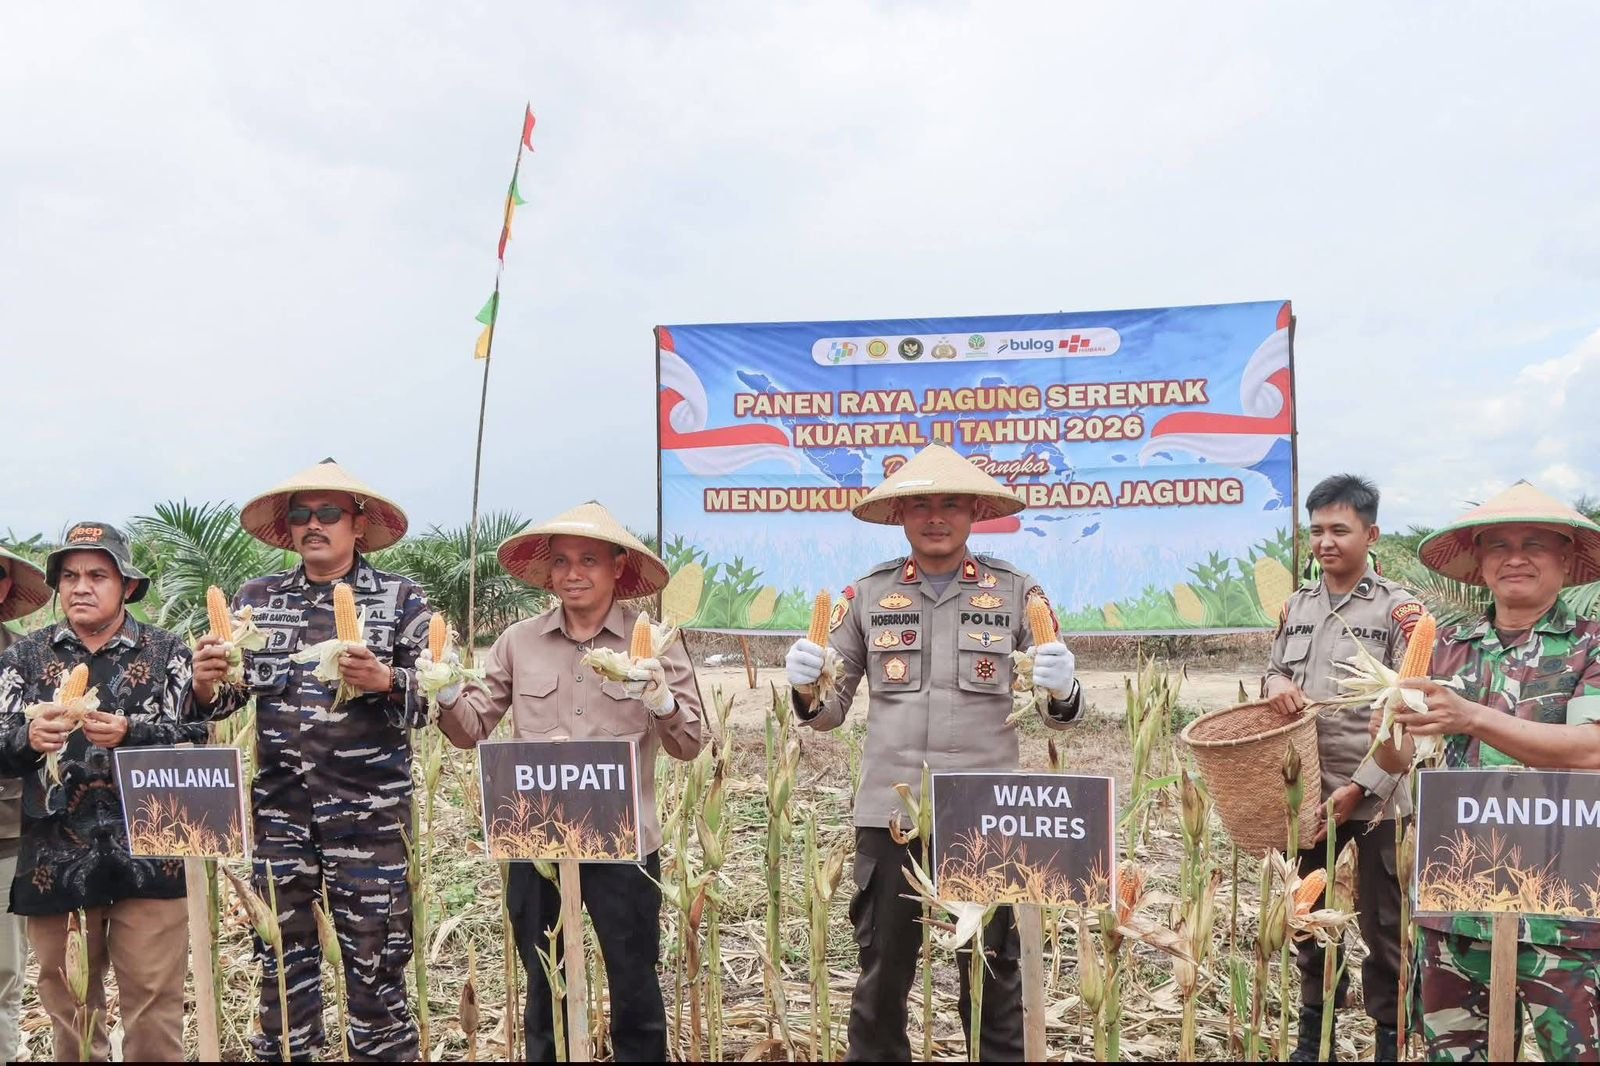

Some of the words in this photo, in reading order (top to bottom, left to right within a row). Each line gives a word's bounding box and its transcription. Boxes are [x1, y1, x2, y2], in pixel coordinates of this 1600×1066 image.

[1010, 338, 1054, 352] bulog
[735, 392, 833, 417] PANEN
[839, 390, 917, 416] RAYA
[921, 386, 1041, 413] JAGUNG
[1046, 379, 1208, 408] SERENTAK
[794, 422, 926, 448] KUARTAL
[931, 421, 953, 445] II
[958, 417, 1058, 444] TAHUN
[1064, 415, 1144, 441] 2026
[966, 453, 1050, 482] Rangka
[704, 488, 872, 512] MENDUKUN
[1117, 477, 1244, 507] JAGUNG
[369, 610, 387, 619] AL
[871, 613, 919, 626] HOERRUDIN
[960, 612, 1010, 627] POLRI
[1341, 626, 1388, 641] POLRI
[130, 768, 235, 789] DANLANAL
[514, 764, 626, 791] BUPATI
[993, 784, 1072, 809] WAKA
[1457, 796, 1600, 828] DANDIM
[980, 814, 1086, 840] POLRES
